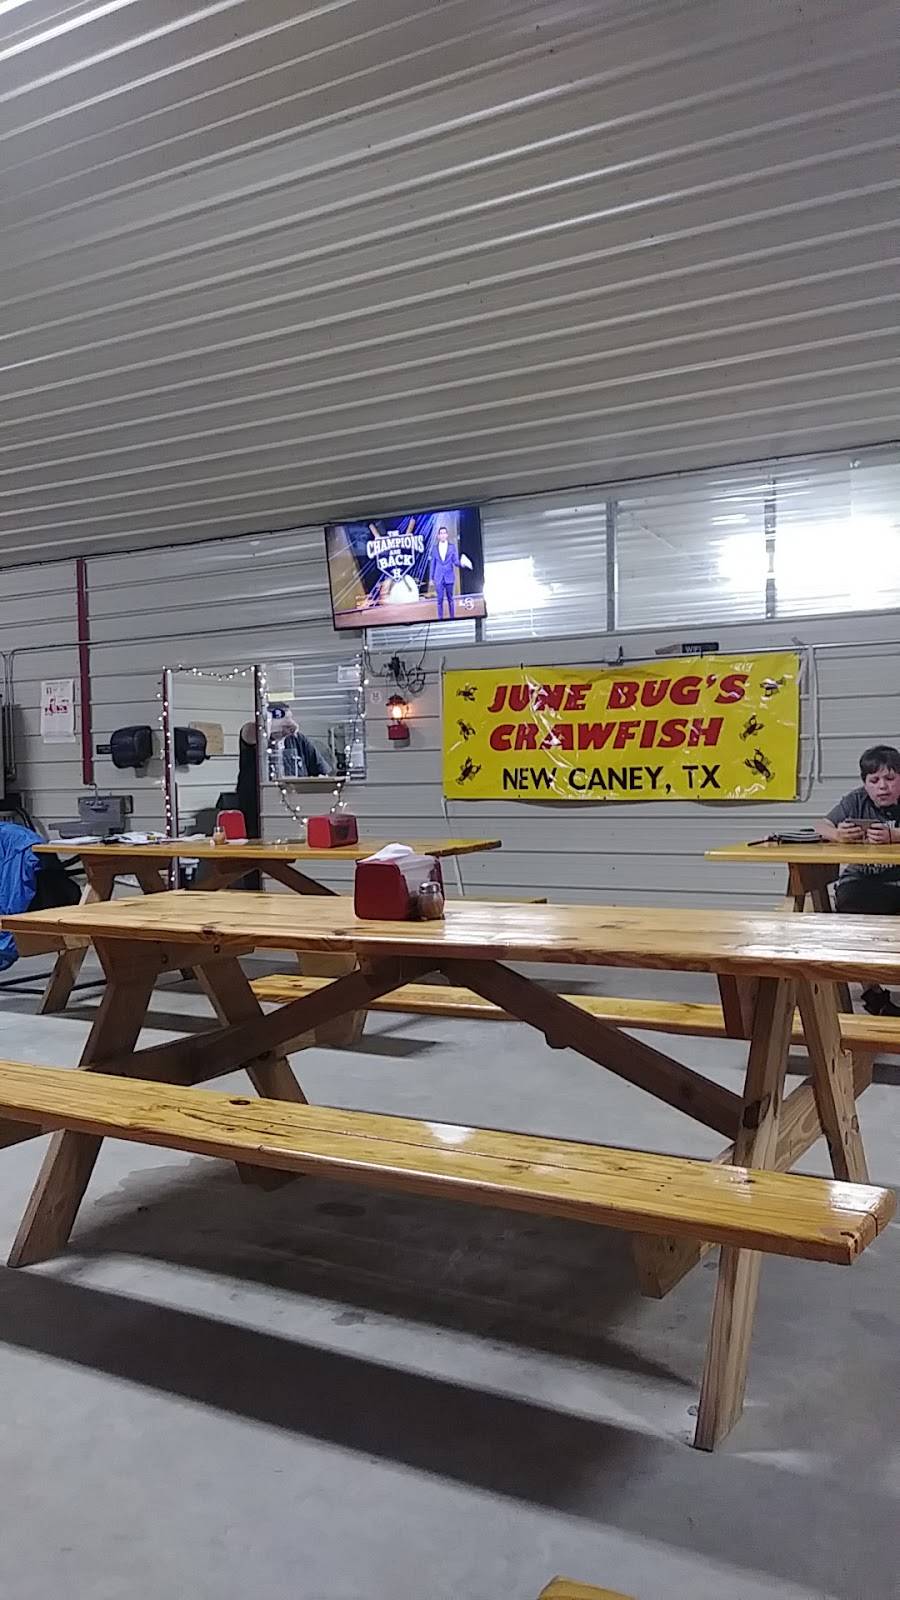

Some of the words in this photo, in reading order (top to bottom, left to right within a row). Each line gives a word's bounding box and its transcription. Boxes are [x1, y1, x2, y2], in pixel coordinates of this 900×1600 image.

[366, 535, 425, 559] CHAMPIONS
[379, 554, 413, 569] BACK
[487, 683, 593, 713] JUNE
[606, 674, 749, 710] BUG'S
[489, 717, 725, 751] CRAWFISH
[503, 767, 558, 790] NEW
[568, 766, 672, 794] CANEY,
[682, 764, 721, 789] TX
